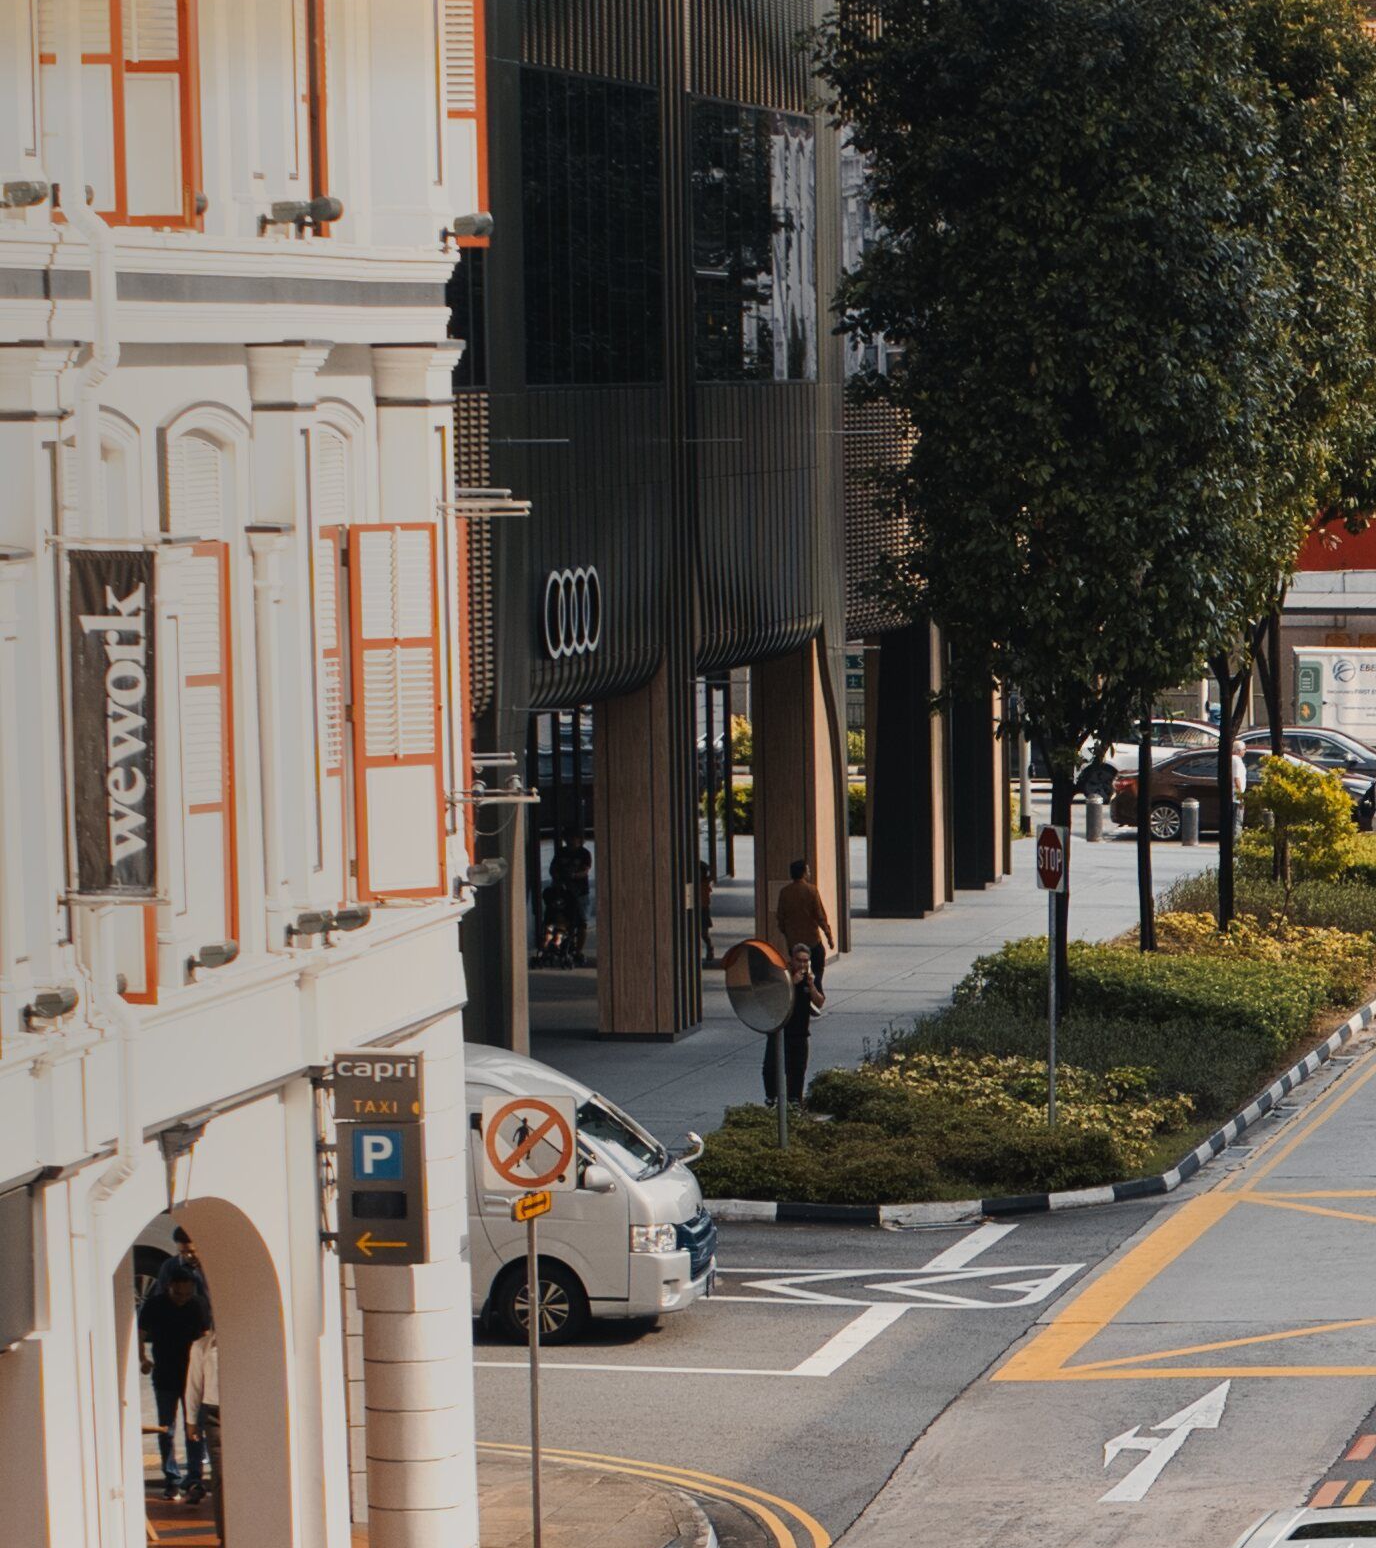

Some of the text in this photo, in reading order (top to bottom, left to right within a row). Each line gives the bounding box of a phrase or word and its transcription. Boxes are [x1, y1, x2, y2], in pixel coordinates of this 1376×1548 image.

[79, 582, 147, 866] wework
[336, 1058, 416, 1083] capri
[353, 1100, 398, 1114] TAXI
[361, 1135, 394, 1174] P
